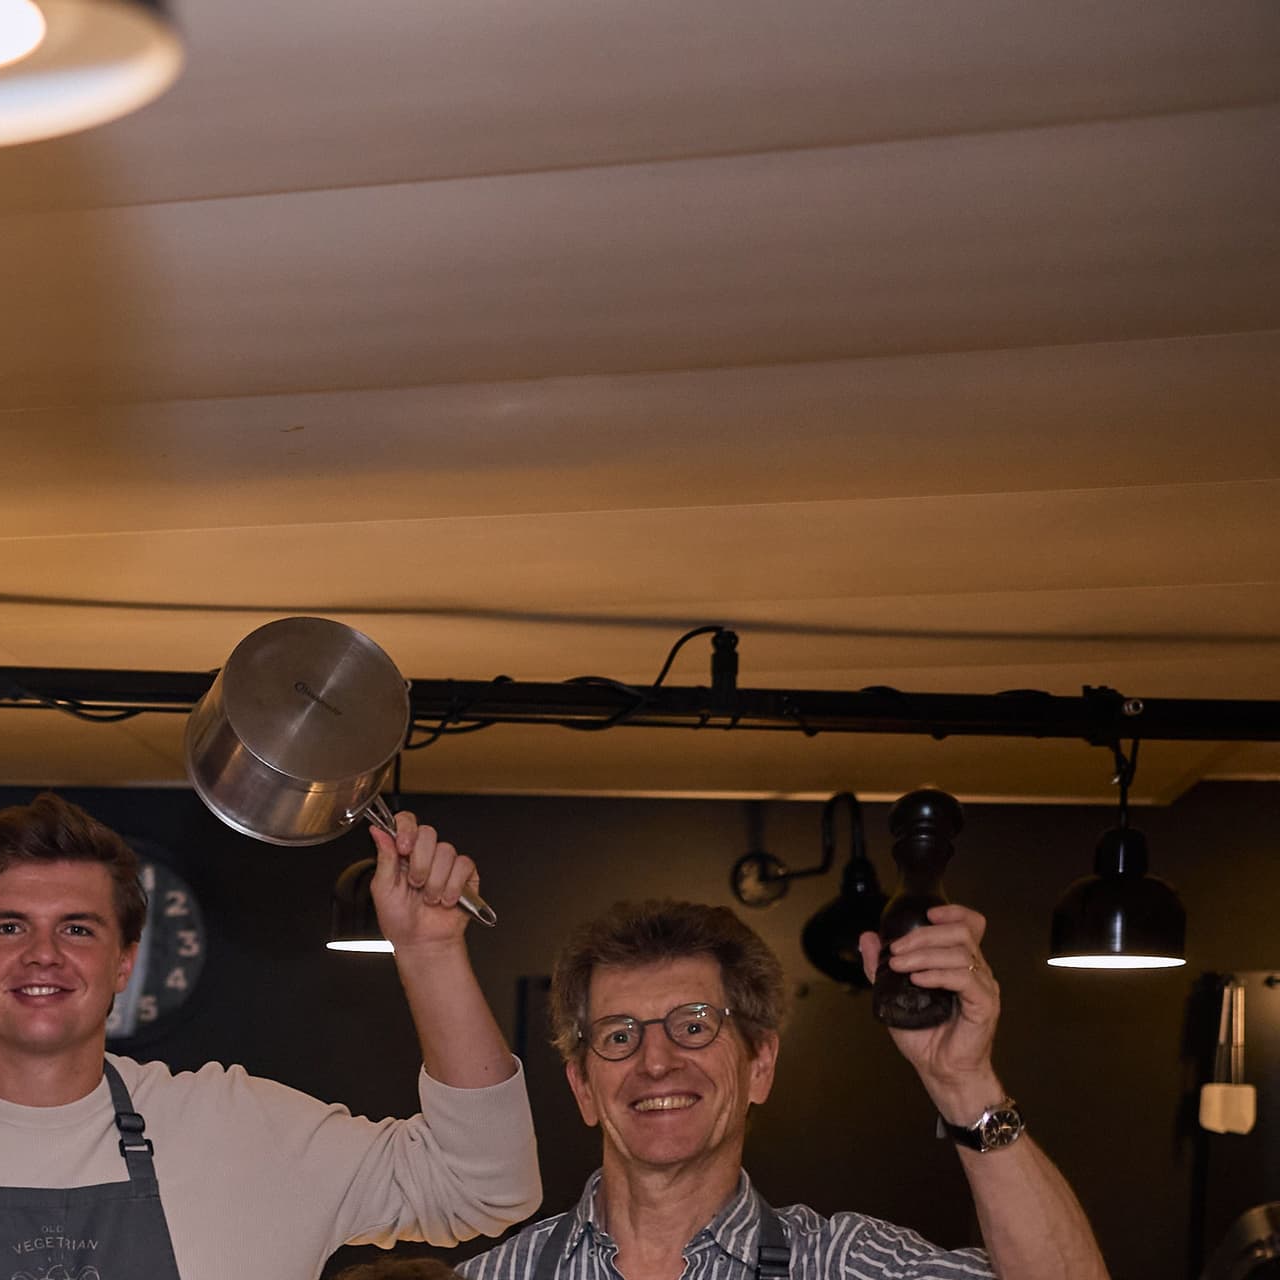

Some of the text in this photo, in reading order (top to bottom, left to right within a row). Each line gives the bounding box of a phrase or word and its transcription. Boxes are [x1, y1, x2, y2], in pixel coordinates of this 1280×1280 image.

[164, 890, 189, 917] 2
[177, 929, 201, 958] 3
[165, 966, 188, 991] 4
[138, 995, 159, 1022] 5
[12, 1236, 98, 1255] VEGETRIAN
